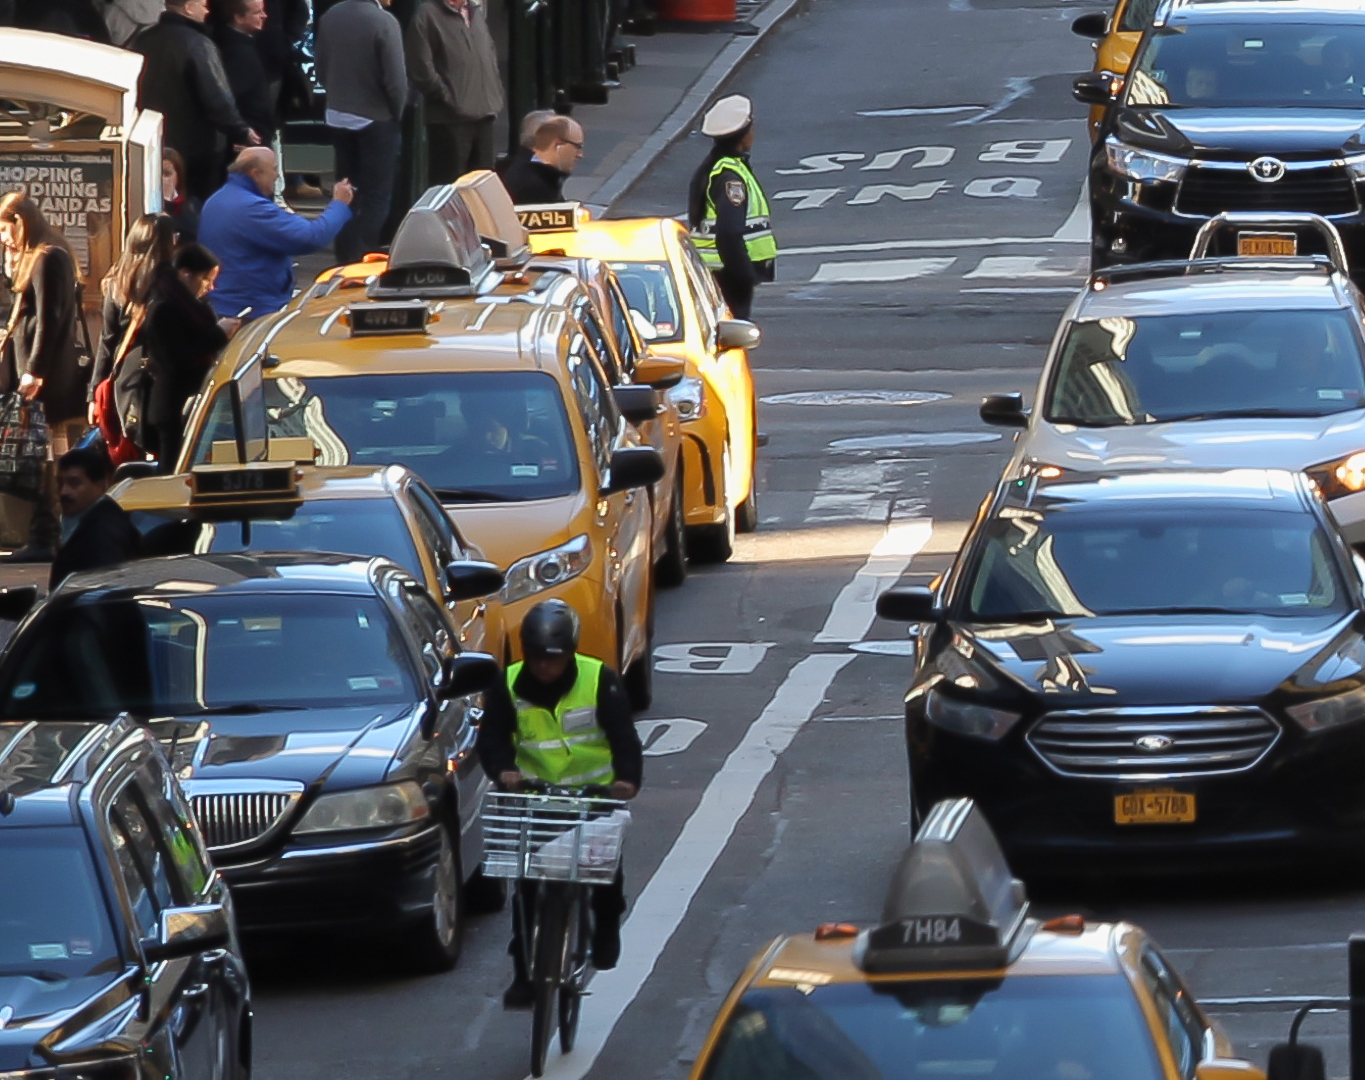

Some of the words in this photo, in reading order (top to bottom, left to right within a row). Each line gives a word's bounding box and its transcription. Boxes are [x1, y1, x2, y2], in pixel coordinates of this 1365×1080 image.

[29, 182, 99, 197] DINING
[770, 177, 1043, 211] ONL
[85, 198, 112, 213] AS
[901, 917, 961, 944] 7H84
